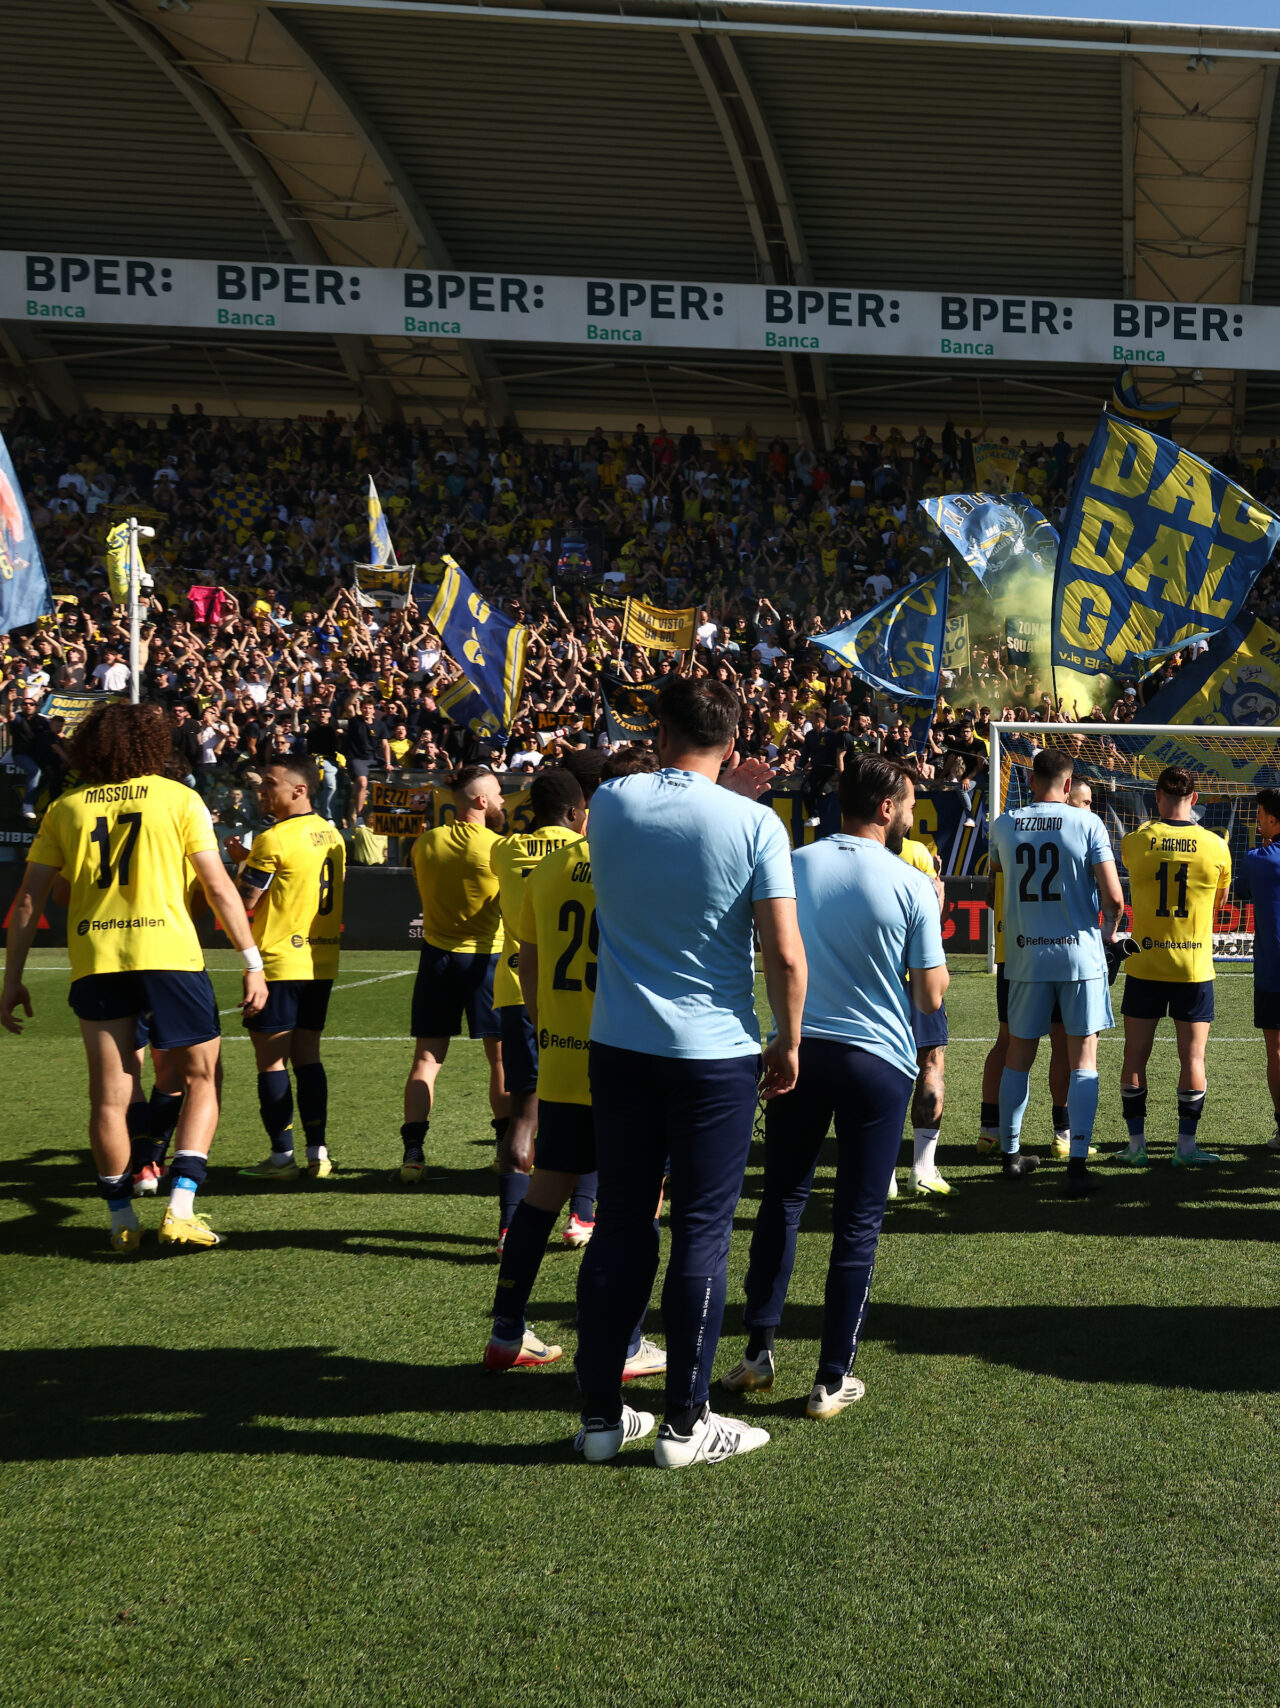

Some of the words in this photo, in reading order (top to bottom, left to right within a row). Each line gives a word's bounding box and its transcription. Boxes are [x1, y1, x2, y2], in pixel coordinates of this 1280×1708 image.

[27, 300, 85, 318] Banca
[218, 309, 275, 326] Banca
[405, 317, 461, 334] Banca
[587, 325, 642, 342] Banca
[766, 332, 819, 348] Banca
[941, 338, 994, 355] Banca
[1113, 345, 1165, 361] Banca
[1070, 496, 1236, 619] DAL
[659, 617, 685, 629] VISTO
[944, 636, 966, 654] LO
[85, 785, 149, 803] MASSOLIN
[376, 786, 409, 806] PEZZI
[1014, 817, 1063, 831] PEZZOLATO
[90, 812, 142, 889] 17
[1162, 837, 1197, 853] MENDES
[1016, 842, 1062, 902] 22
[318, 856, 335, 916] 8
[1155, 862, 1189, 918] 11
[92, 917, 165, 931] Reflexallen
[1026, 936, 1080, 947] Reflexallen
[1154, 940, 1203, 950] Reflexallen
[551, 1034, 590, 1051] Reflex
